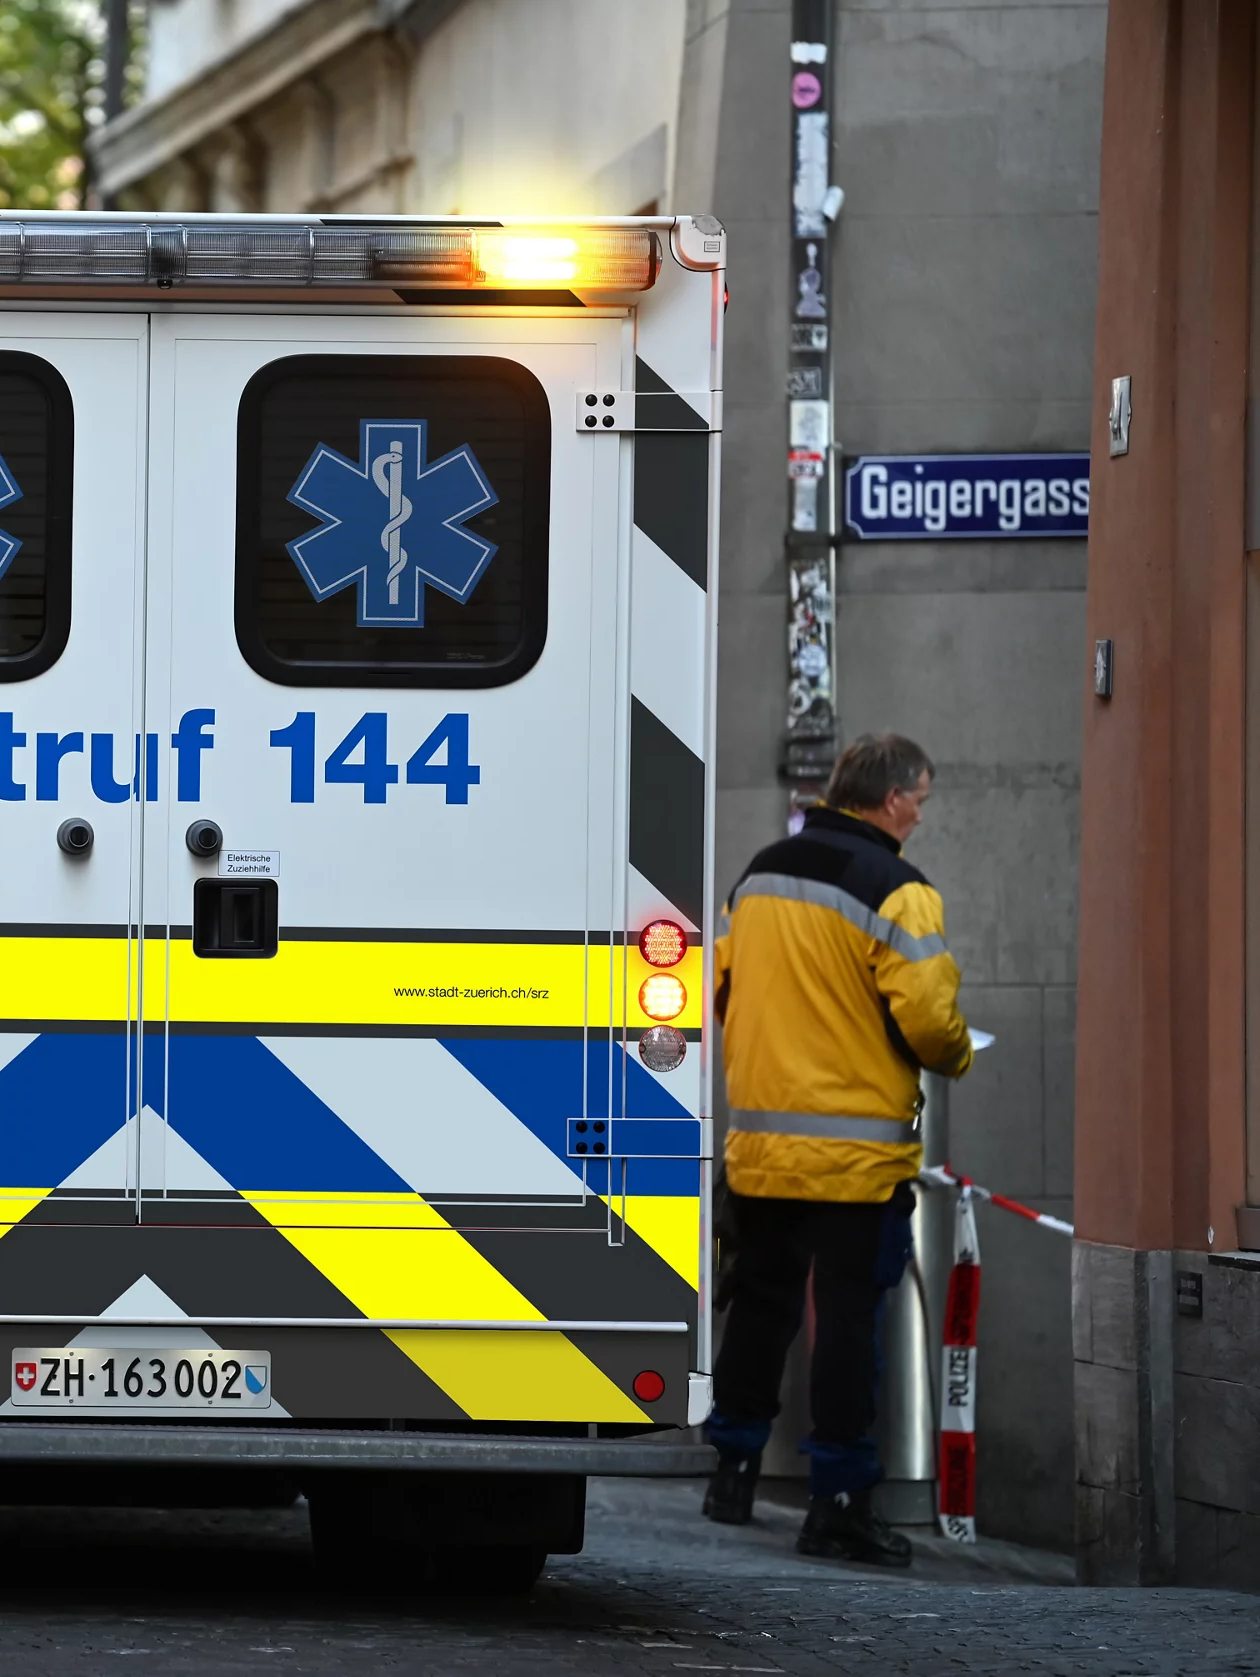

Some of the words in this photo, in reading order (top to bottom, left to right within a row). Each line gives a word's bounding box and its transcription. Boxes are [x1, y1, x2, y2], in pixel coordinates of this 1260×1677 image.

[860, 463, 1090, 532] Geigergass
[269, 711, 481, 805] 144
[227, 853, 271, 863] Elektrische
[227, 864, 271, 873] Zuziehhilfe
[393, 986, 550, 999] www.stadt-zuerich.ch/srz
